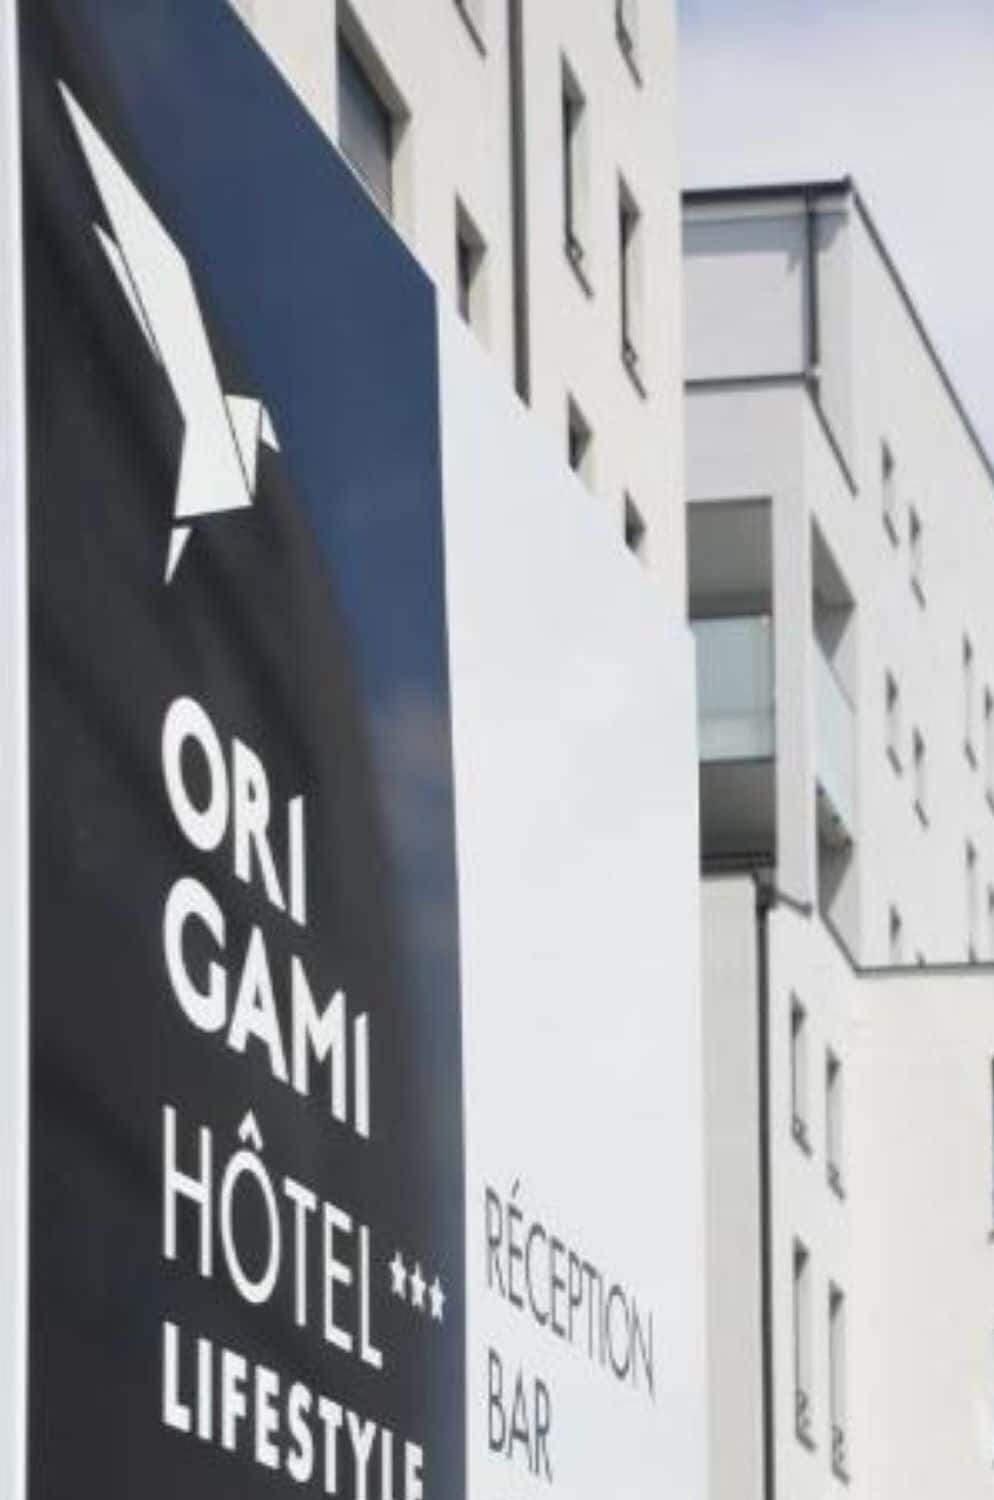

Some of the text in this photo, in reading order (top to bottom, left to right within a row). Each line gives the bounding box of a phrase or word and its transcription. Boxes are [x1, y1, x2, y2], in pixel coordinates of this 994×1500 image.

[162, 697, 307, 927] ORI
[163, 875, 370, 1139] GAMI
[163, 1106, 383, 1370] HÔTEL
[485, 1178, 655, 1401] RÉCEPTION
[487, 1347, 553, 1482] BAR
